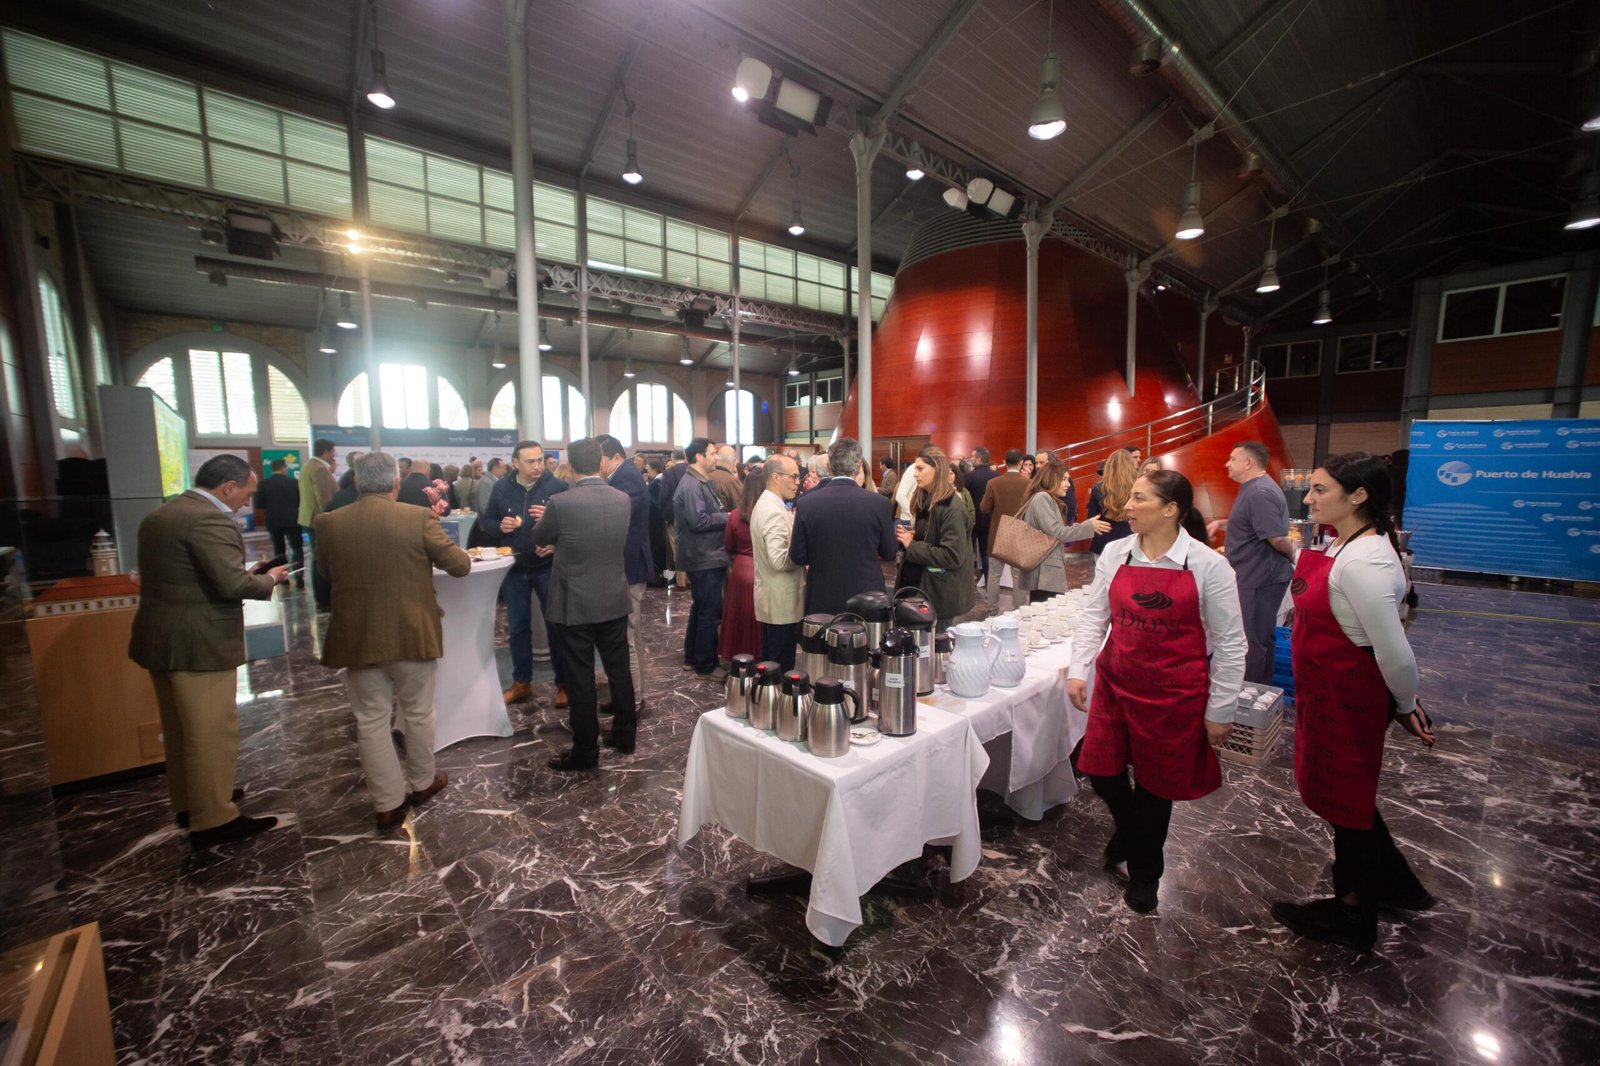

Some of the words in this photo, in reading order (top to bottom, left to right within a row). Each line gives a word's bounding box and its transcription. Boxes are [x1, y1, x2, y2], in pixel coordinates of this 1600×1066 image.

[1475, 469, 1519, 479] Puerto
[1521, 469, 1539, 479] de
[1542, 470, 1592, 479] Huelva
